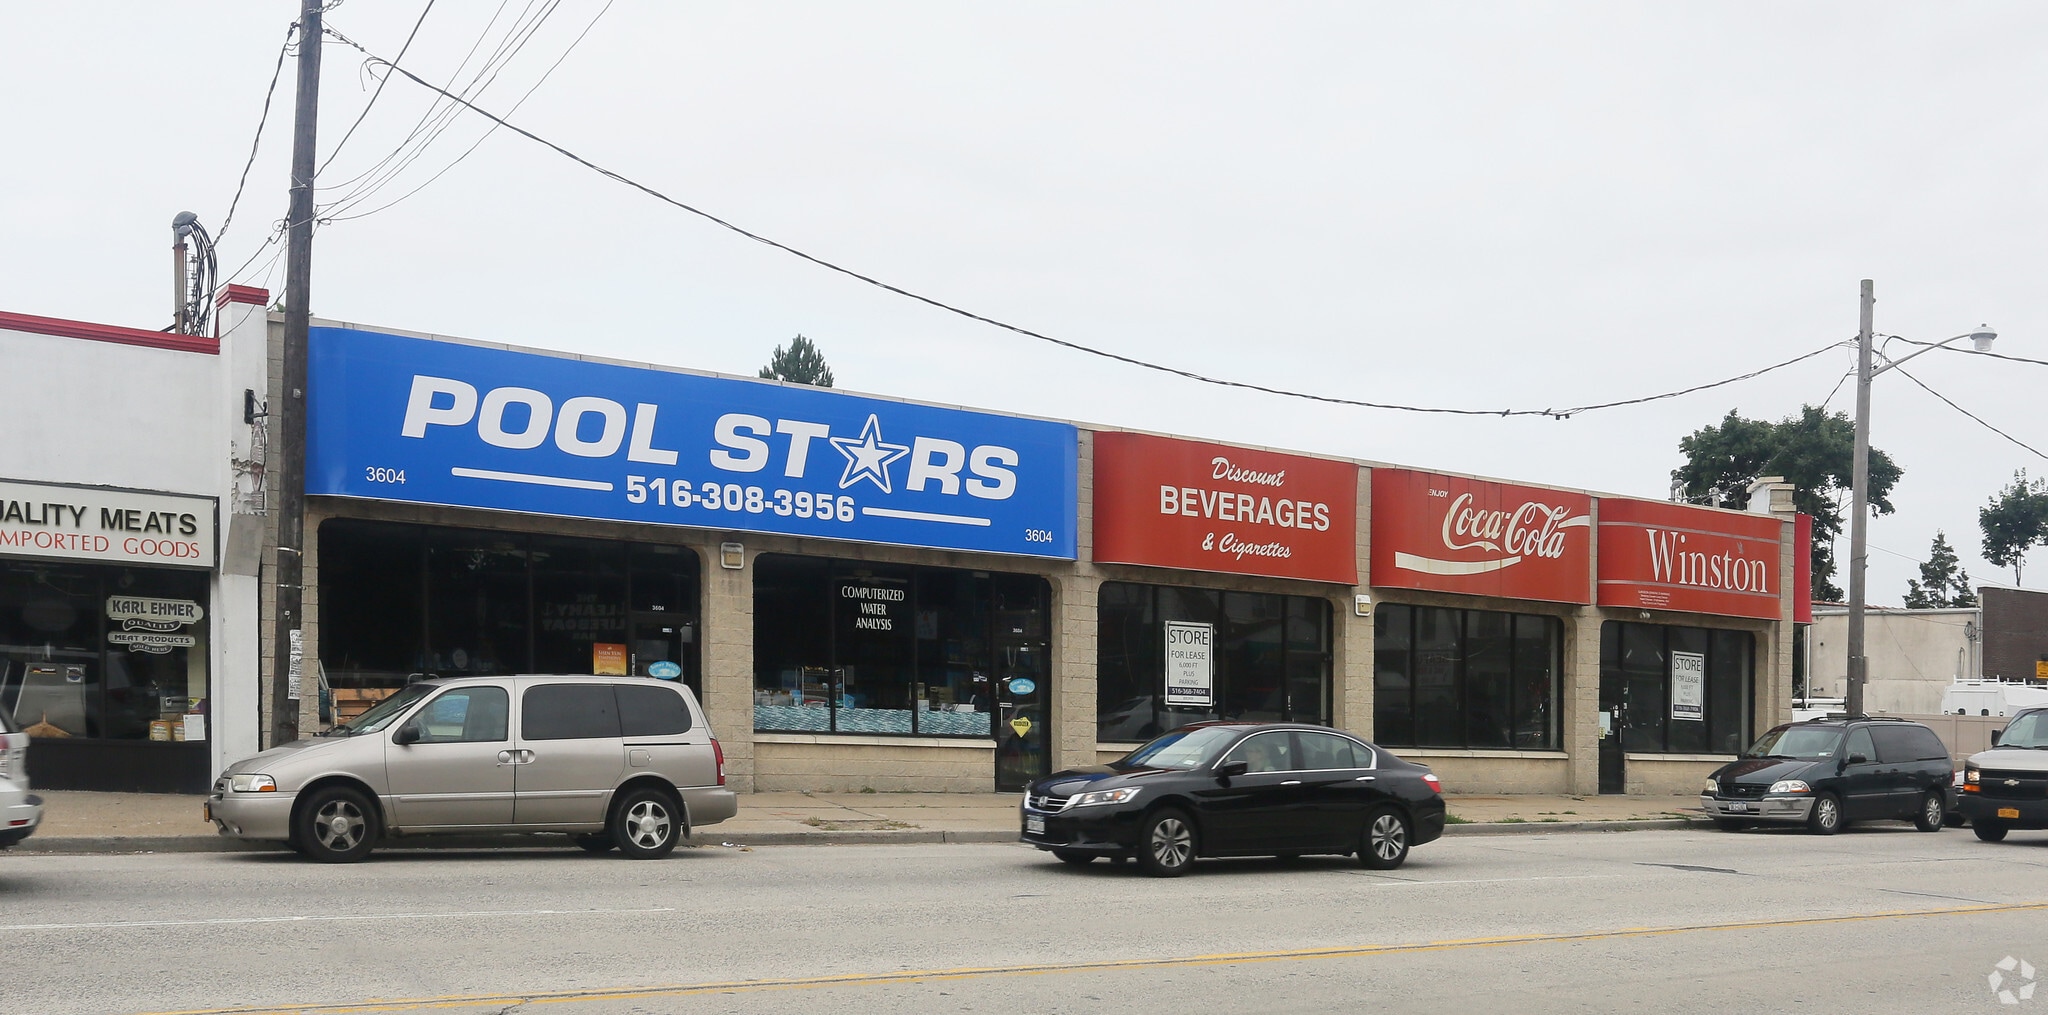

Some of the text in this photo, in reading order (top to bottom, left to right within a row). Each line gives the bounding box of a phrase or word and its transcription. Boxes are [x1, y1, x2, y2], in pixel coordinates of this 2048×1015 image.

[401, 374, 679, 466] POOL
[365, 466, 406, 485] 3604
[1211, 456, 1286, 487] Discount
[626, 475, 855, 522] 516-308-3956
[1428, 488, 1448, 498] ENJOY
[0, 500, 197, 535] ALITY MEATS
[1160, 485, 1330, 532] BEVERAGES
[1442, 492, 1571, 559] Coca-Cola
[1024, 528, 1053, 544] 3604
[124, 537, 200, 559] GOODS
[1201, 532, 1292, 561] & Cigarettes
[1646, 528, 1768, 594] Winston
[841, 585, 905, 602] COMPUTERIZED
[112, 599, 195, 618] KARL EHMER
[860, 602, 887, 616] WATER
[127, 620, 176, 630] QUALITY
[855, 617, 892, 631] ANALYSIS
[114, 634, 191, 644] MEAT PRODUCTS
[1169, 629, 1208, 646] STORE
[1171, 650, 1206, 660] FOR LEASE
[1675, 658, 1702, 672] STORE
[1685, 675, 1700, 683] LEASE
